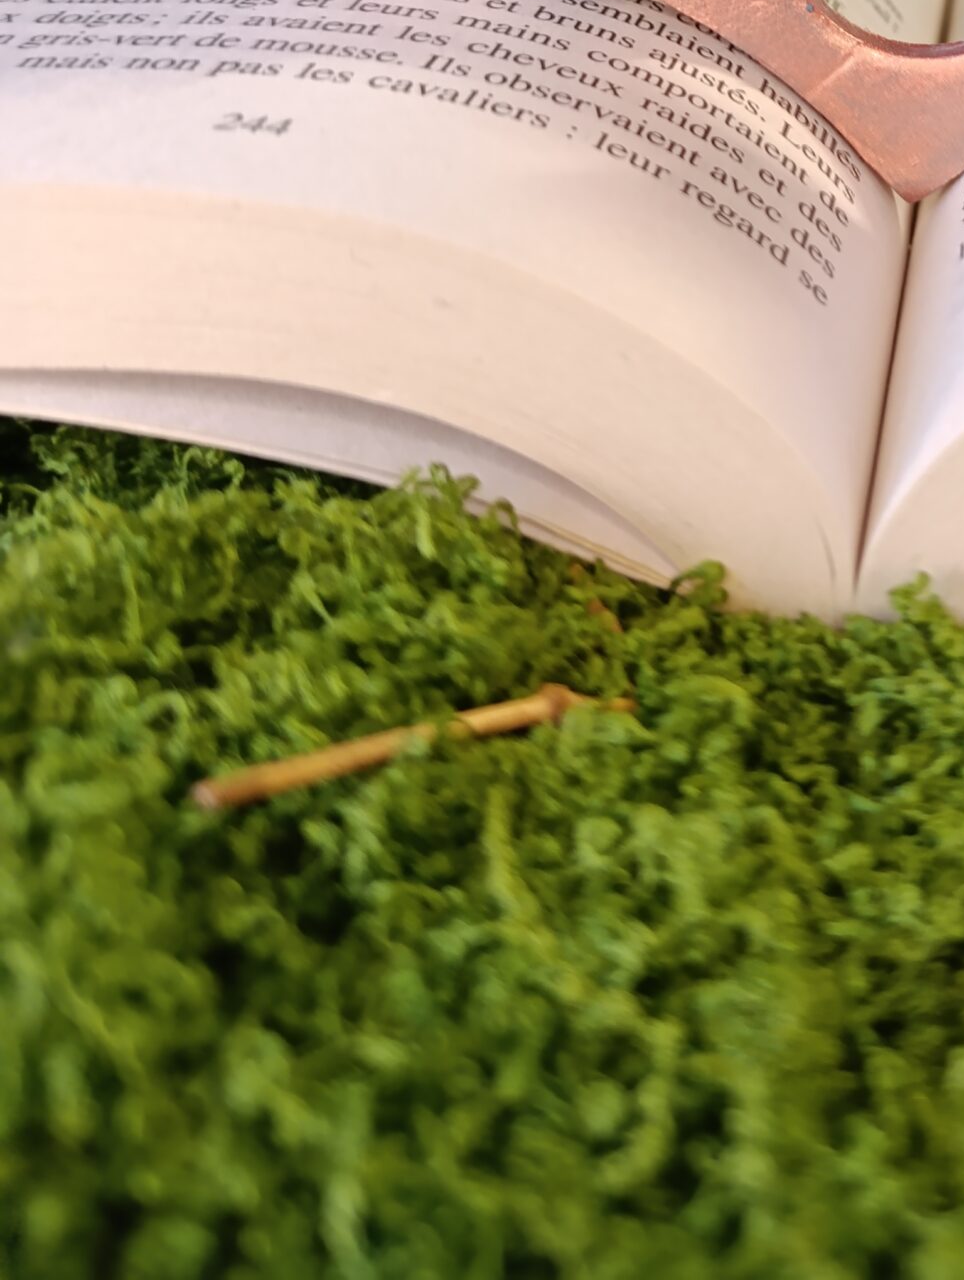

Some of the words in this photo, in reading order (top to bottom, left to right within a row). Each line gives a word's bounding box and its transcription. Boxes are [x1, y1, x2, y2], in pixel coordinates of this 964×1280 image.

[16, 53, 113, 69] mais
[124, 55, 201, 71] non
[204, 58, 284, 78] pas
[293, 62, 355, 84] les
[593, 131, 672, 181] leur
[679, 178, 790, 268] regard
[798, 269, 829, 307] se
[17, 30, 188, 50] gris-vert
[194, 32, 242, 48] de
[248, 37, 404, 66] mousse.
[421, 53, 473, 78] Ils
[483, 70, 704, 168] observaient
[709, 165, 783, 223] avec
[789, 225, 835, 279] des
[180, 10, 229, 25] ils
[241, 14, 383, 37] avaient
[395, 24, 452, 47] les
[467, 41, 624, 99] cheveux
[640, 97, 745, 164] raides
[758, 168, 788, 197] et
[798, 200, 842, 253] des
[213, 111, 293, 136] 244
[454, 14, 571, 52] mains
[587, 50, 808, 186] comportaient
[819, 189, 849, 228] de
[533, 5, 636, 50] bruns
[648, 47, 767, 122] ajustés.
[779, 120, 855, 205] Leurs
[758, 78, 863, 183] habillés
